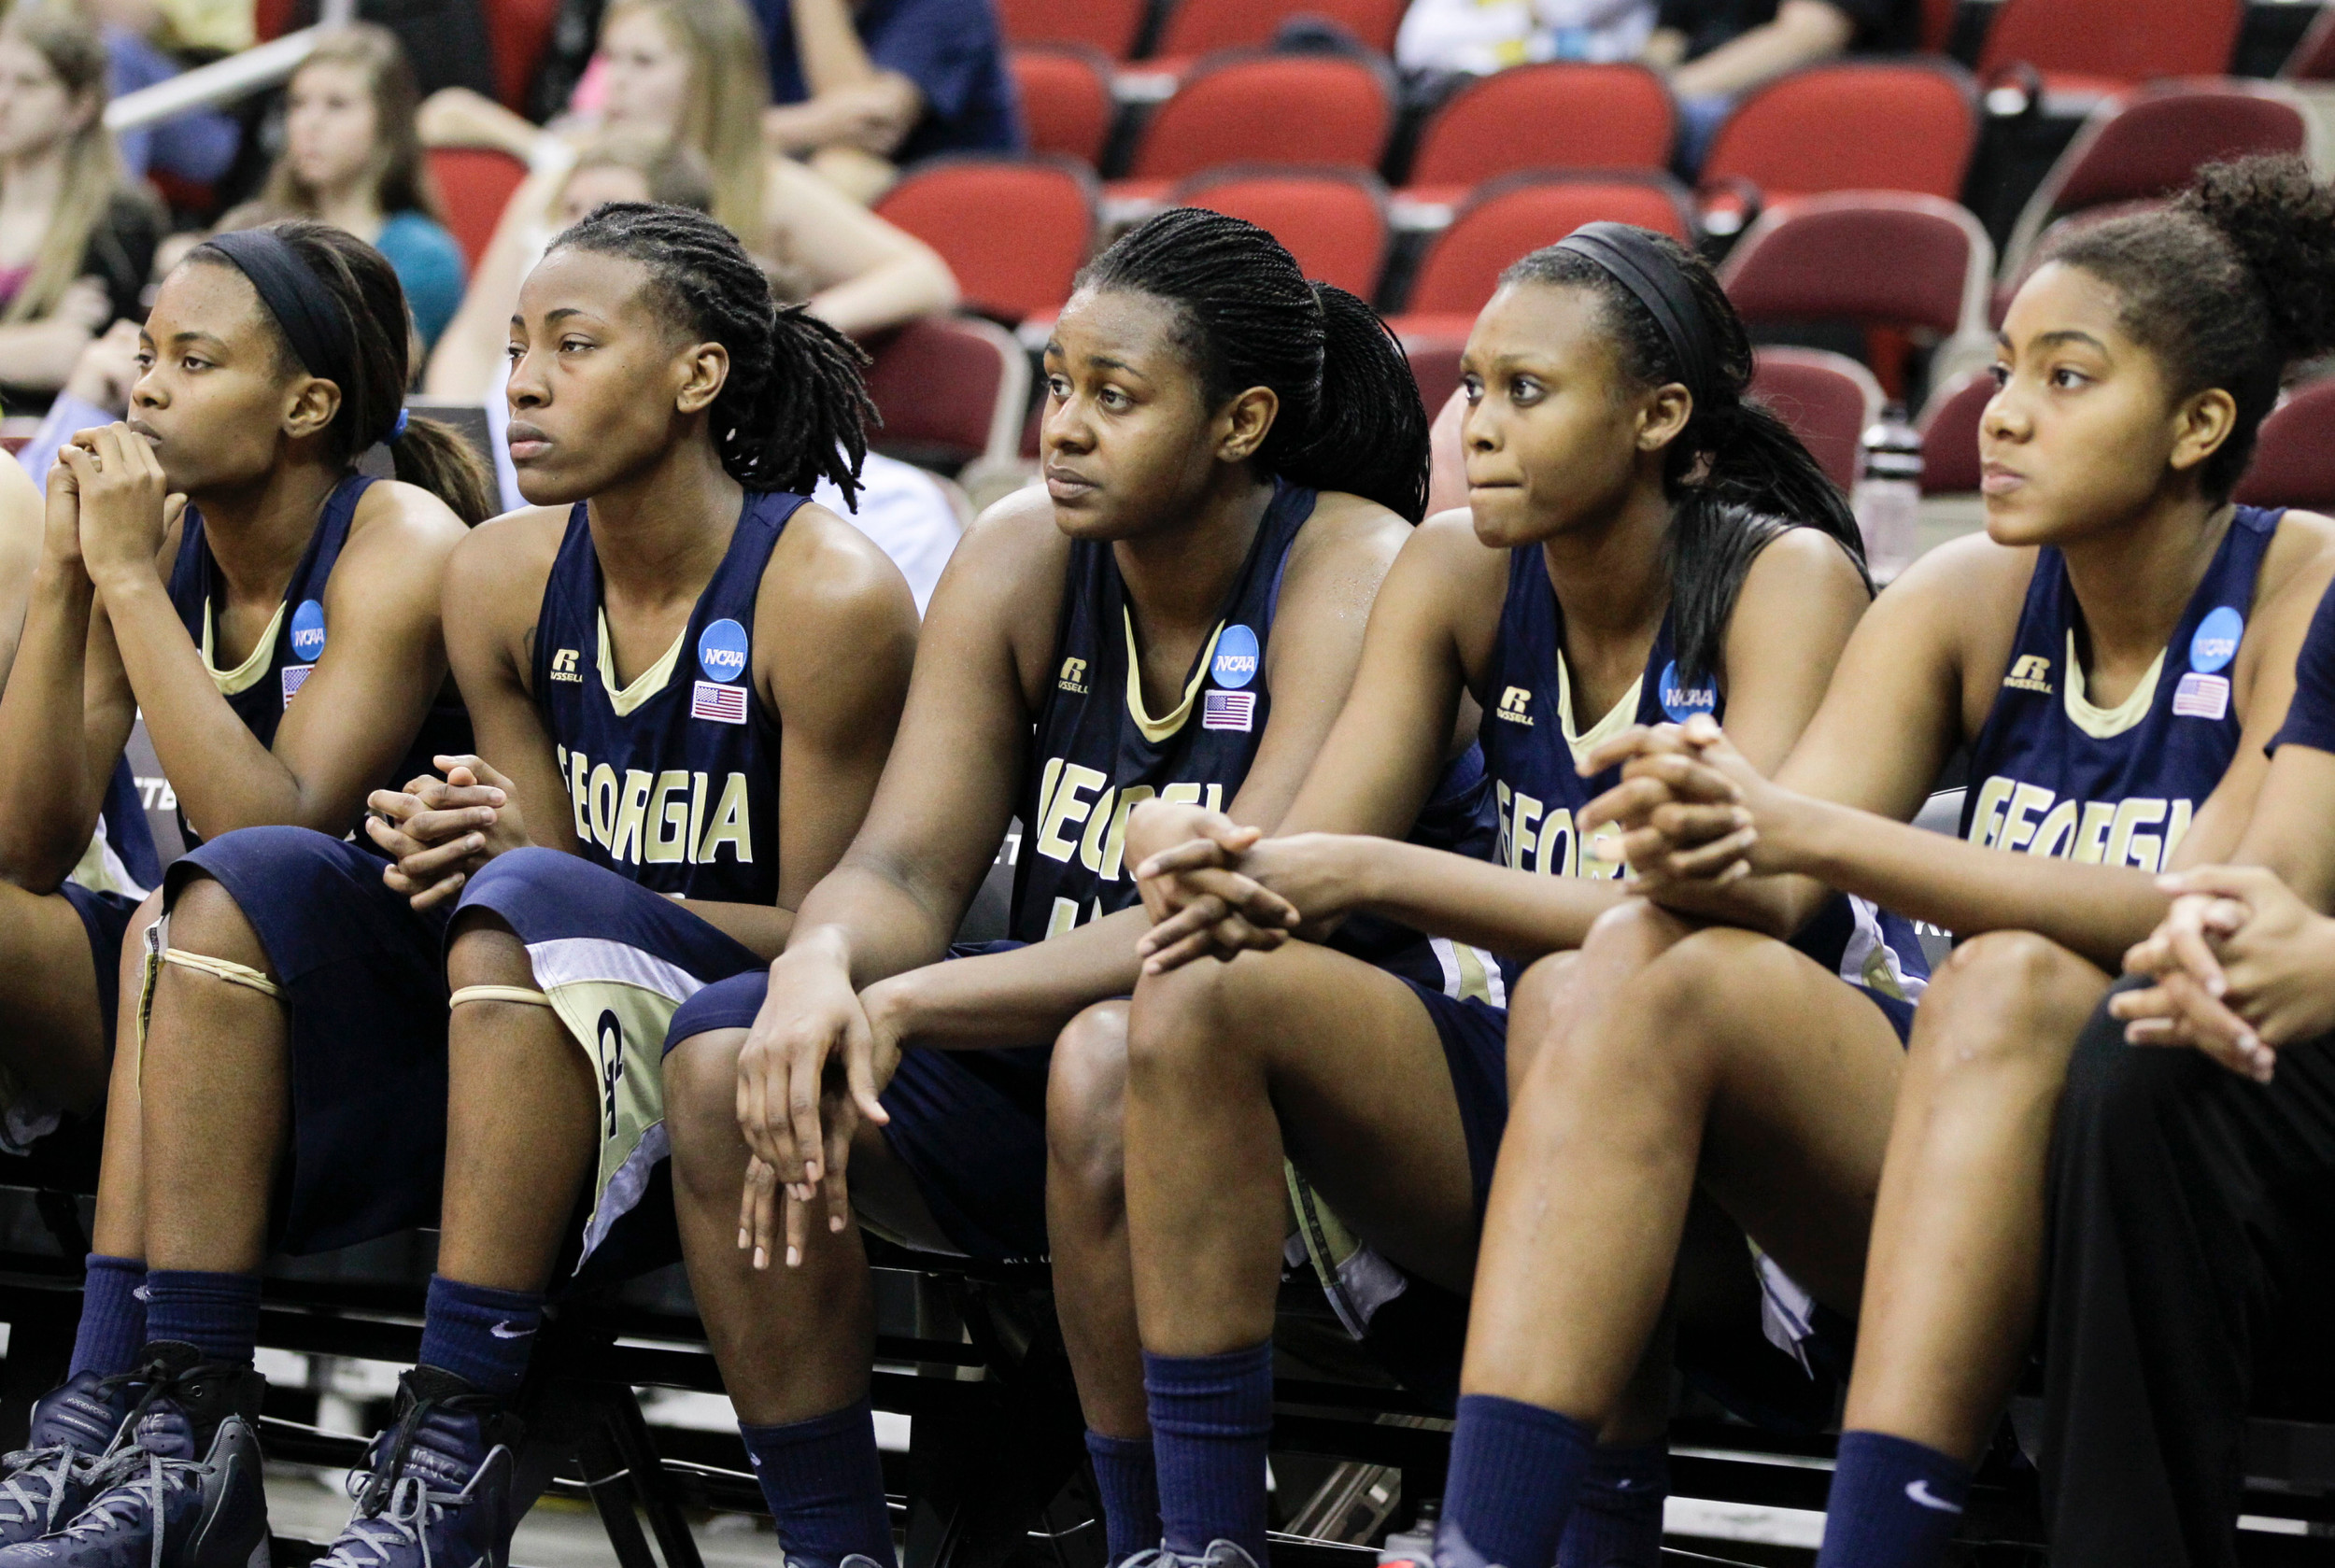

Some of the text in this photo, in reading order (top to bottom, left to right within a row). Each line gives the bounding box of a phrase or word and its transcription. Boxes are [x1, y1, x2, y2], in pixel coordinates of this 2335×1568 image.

[294, 628, 324, 646] NCAA
[704, 647, 744, 668] NCAA
[1215, 655, 1254, 671] NCAA
[550, 671, 583, 683] USSELL
[1058, 680, 1089, 695] USSELL
[1665, 688, 1714, 707] NCAA
